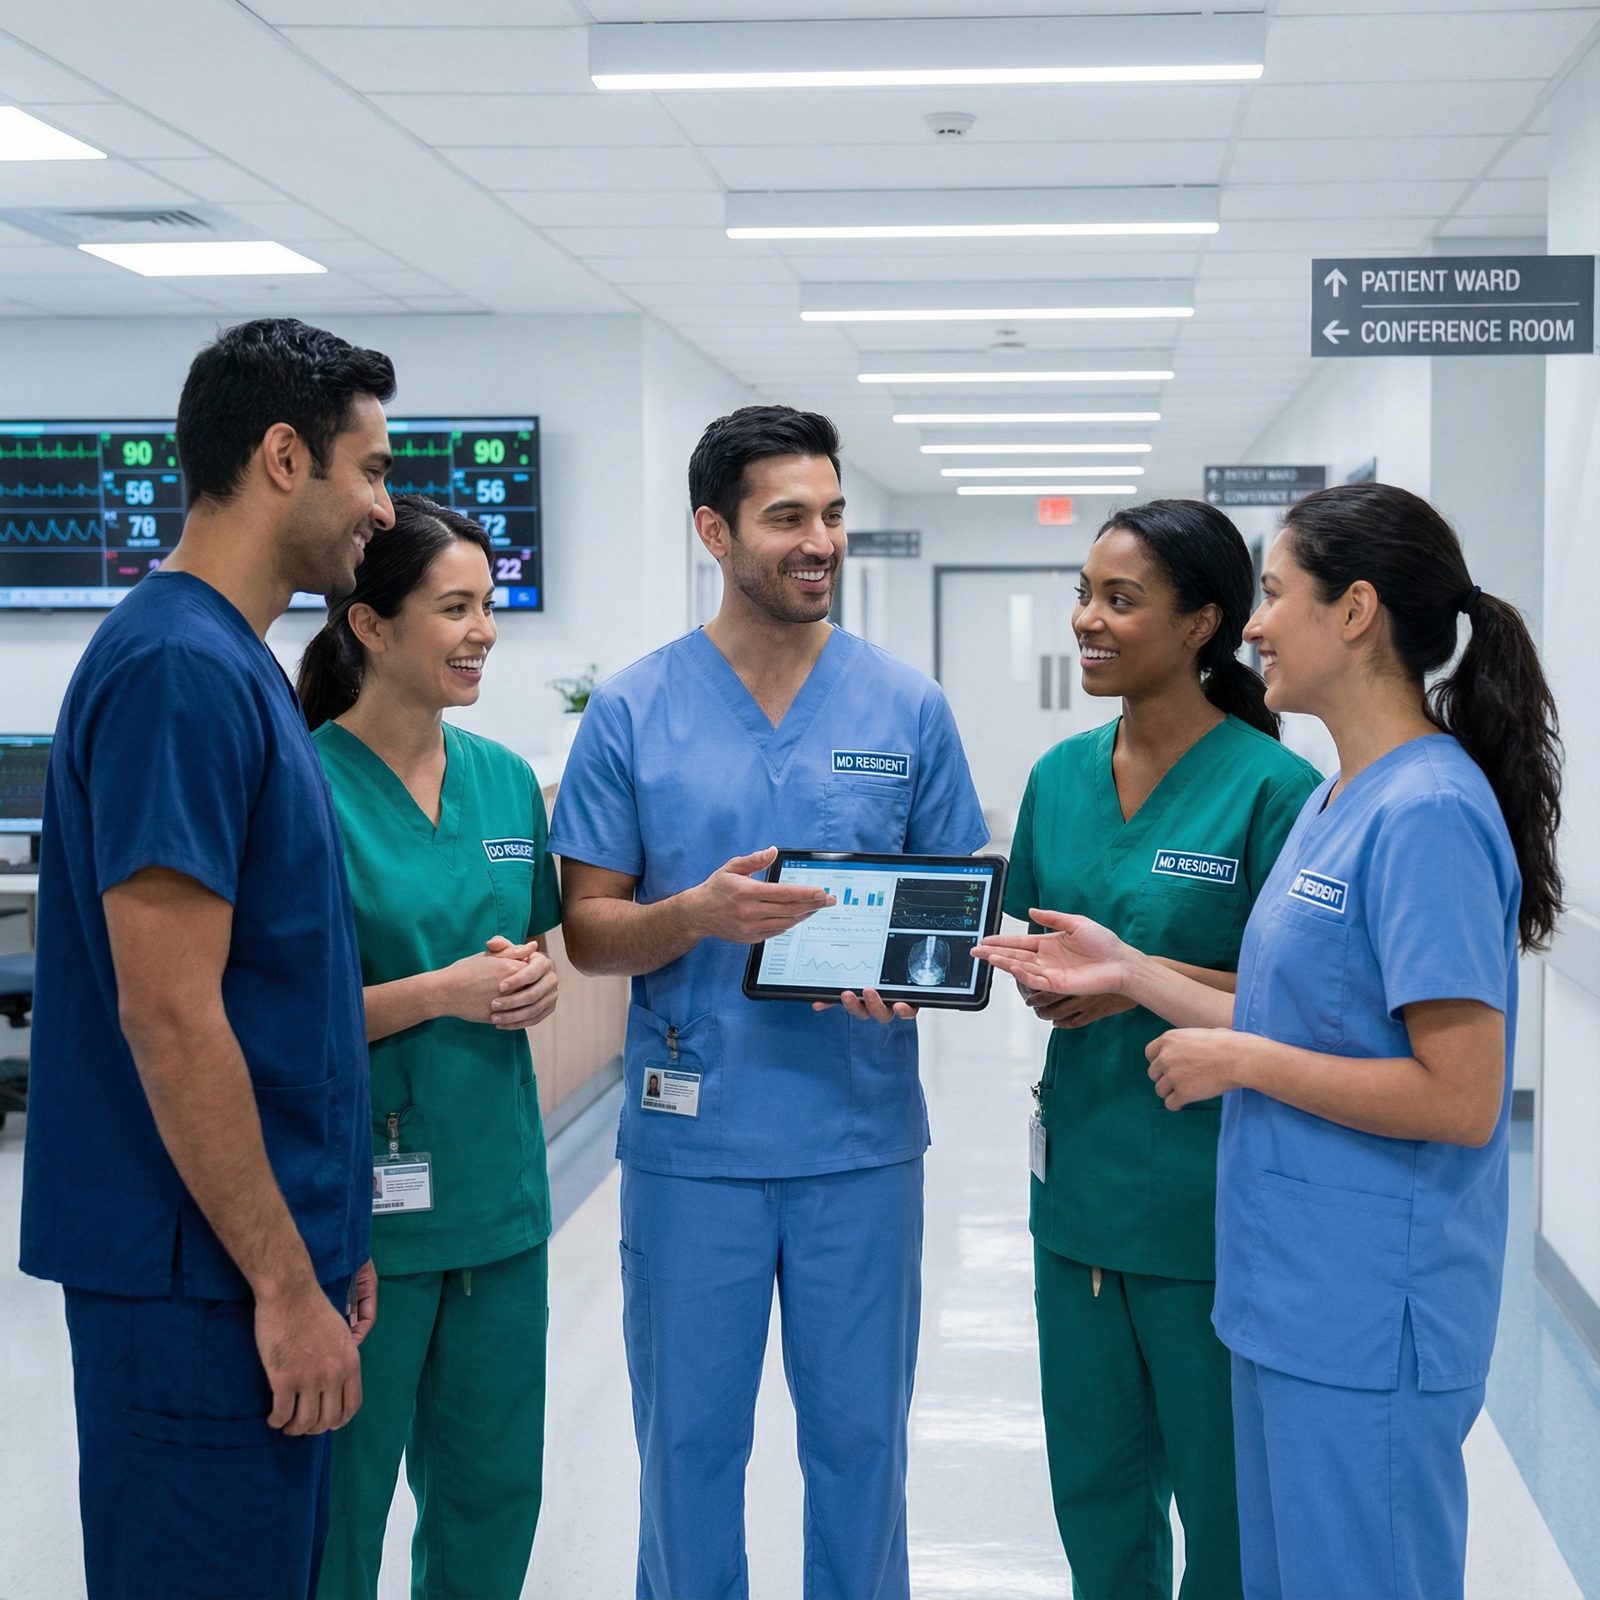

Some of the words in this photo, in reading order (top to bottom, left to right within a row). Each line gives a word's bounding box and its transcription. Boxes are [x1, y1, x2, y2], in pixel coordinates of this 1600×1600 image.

[1361, 270, 1448, 292] PATIENT
[1454, 269, 1521, 291] WARD
[1361, 320, 1502, 344] CONFERENCE
[1508, 319, 1575, 342] ROOM
[122, 440, 153, 466] 90
[474, 438, 505, 464] 90
[125, 480, 155, 505] 56
[476, 479, 506, 503] 56
[478, 514, 507, 536] 72
[496, 558, 522, 580] 22
[836, 755, 853, 768] MD
[856, 756, 905, 773] RESIDENT
[488, 844, 504, 857] DO
[1158, 856, 1176, 869] MD
[1177, 858, 1232, 877] RESIDENT
